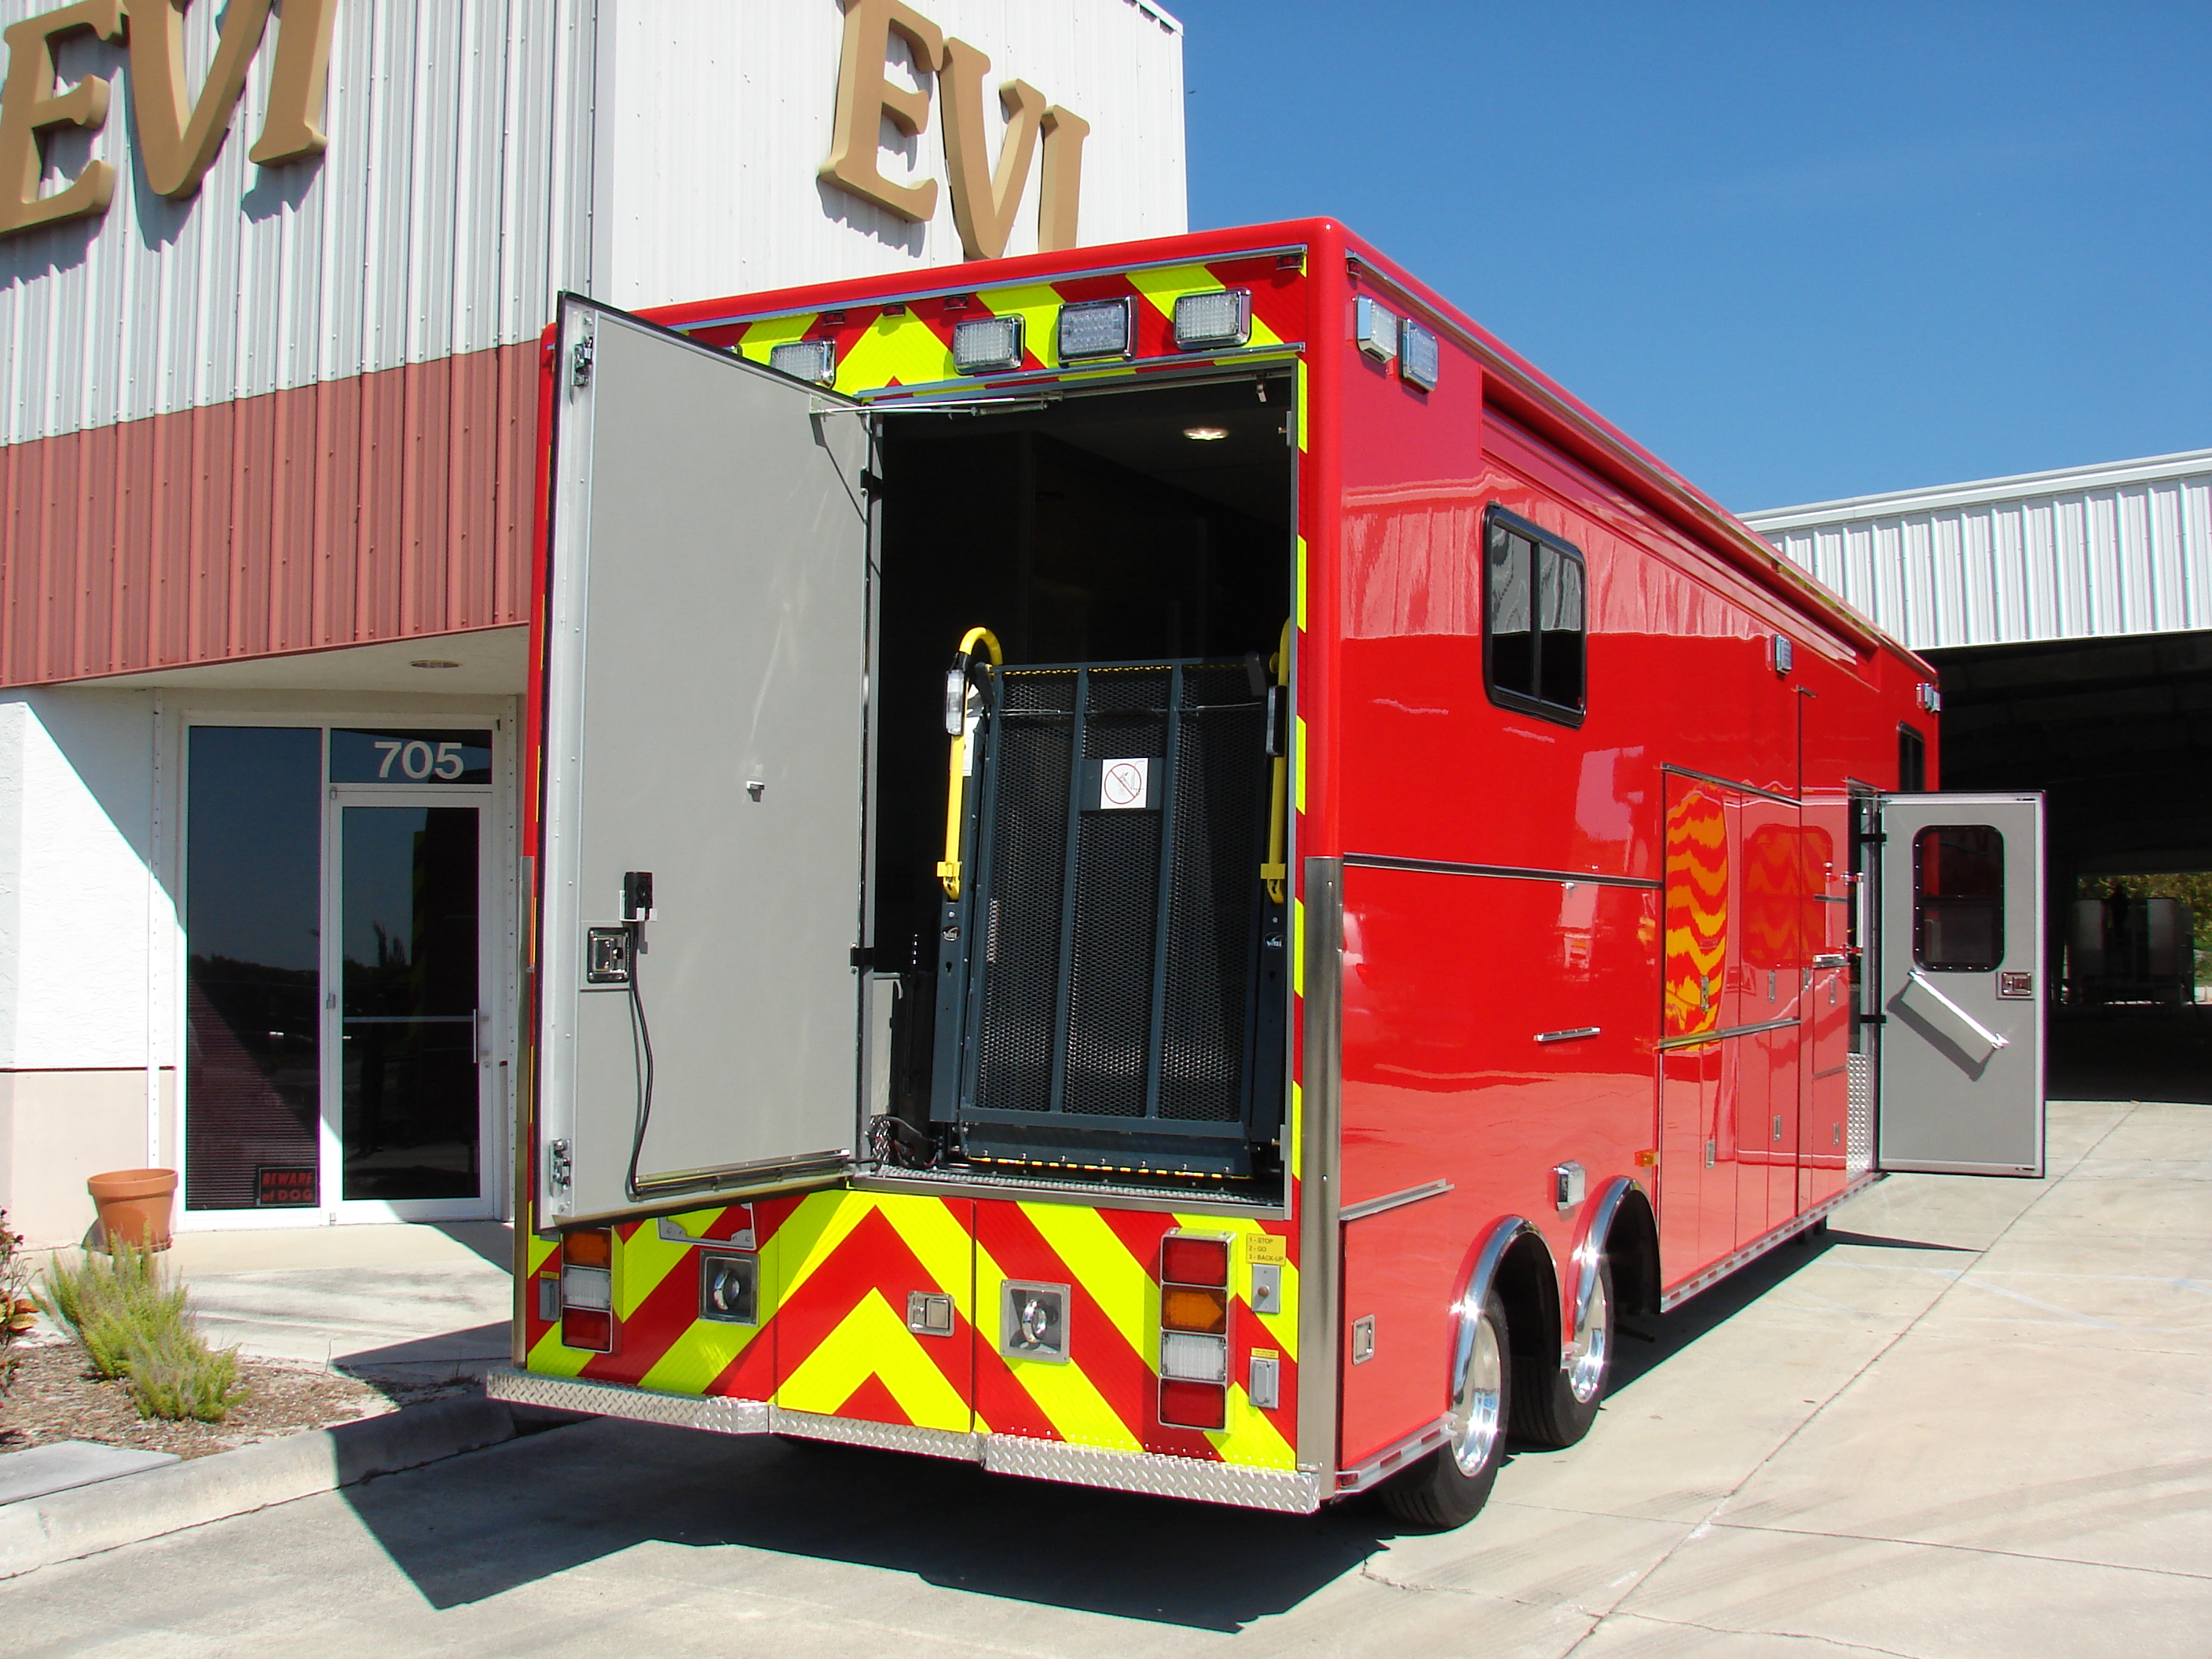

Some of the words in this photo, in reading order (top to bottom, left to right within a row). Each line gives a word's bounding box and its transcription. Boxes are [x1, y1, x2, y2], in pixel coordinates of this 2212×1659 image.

[0, 0, 338, 233] EVI
[818, 0, 1090, 260] EVI
[374, 741, 464, 779] 705
[262, 1173, 313, 1185] BEWARE
[277, 1188, 313, 1201] DOG
